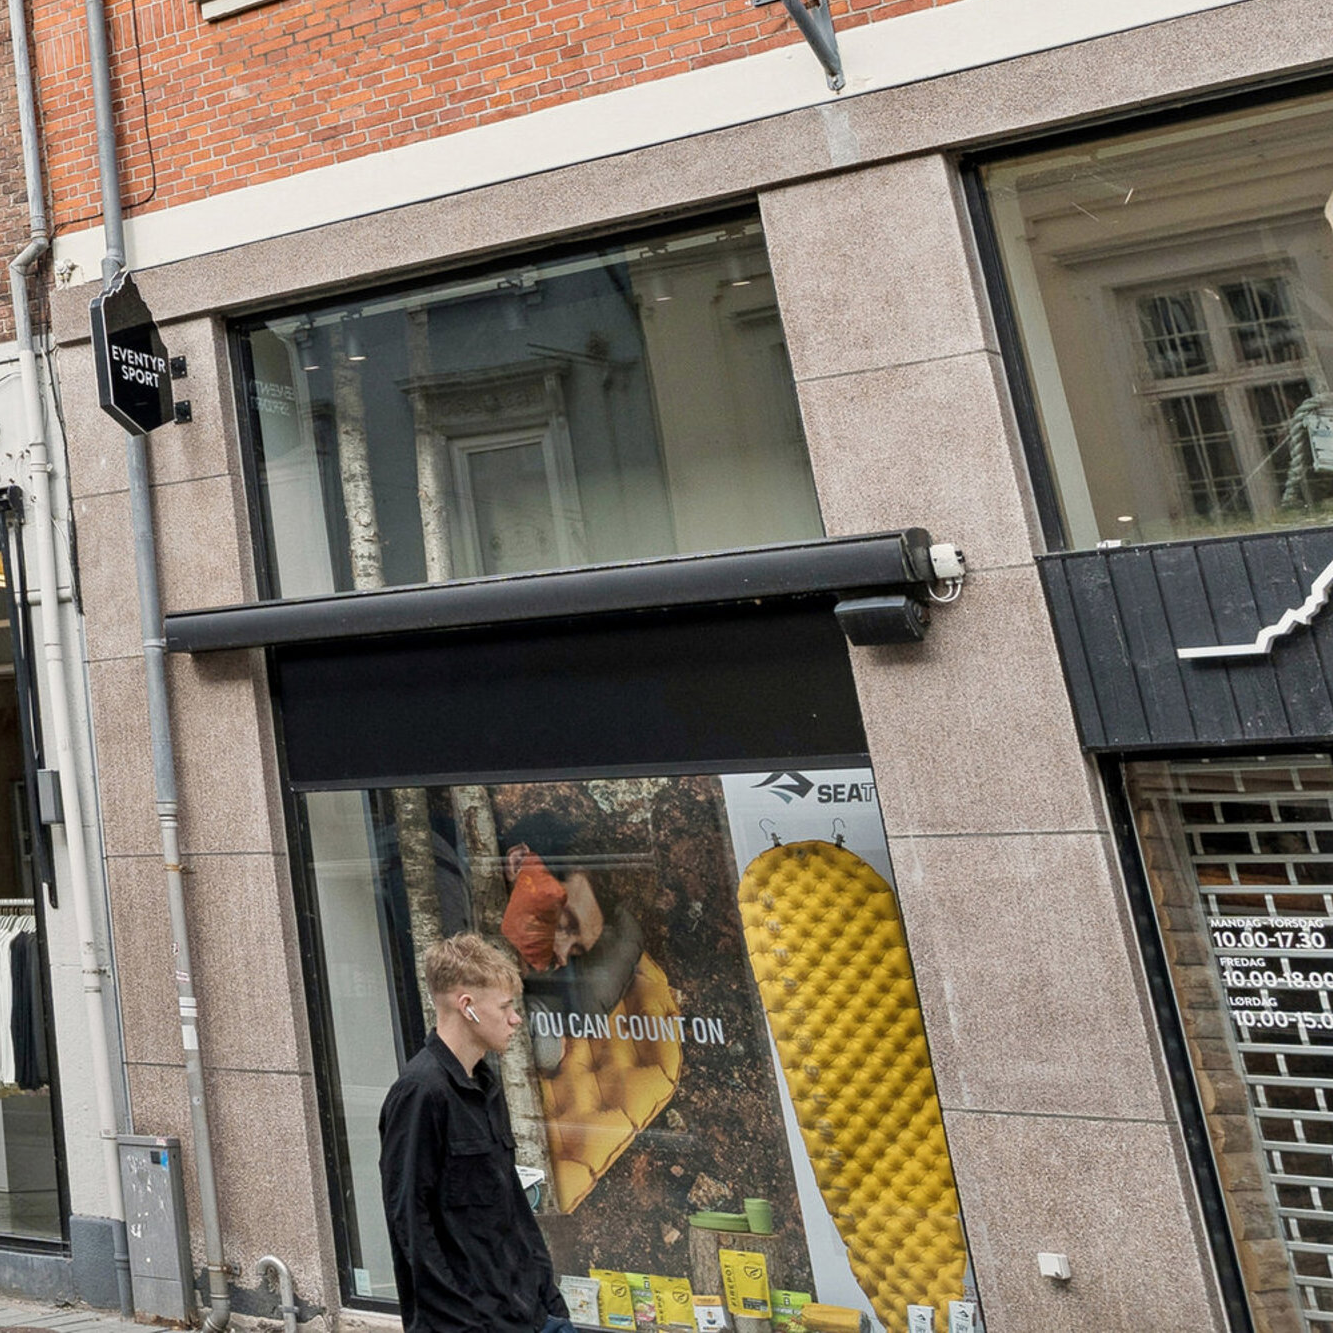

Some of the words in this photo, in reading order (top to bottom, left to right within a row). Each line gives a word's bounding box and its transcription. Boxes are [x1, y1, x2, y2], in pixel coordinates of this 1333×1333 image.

[111, 344, 167, 374] EVENTYR
[121, 365, 160, 389] SPORT
[1213, 930, 1326, 949] 10.00-17.30
[1219, 957, 1266, 967] FREDAG
[1222, 970, 1333, 988] 10.00-18.00
[1229, 997, 1278, 1007] LØRDAG
[568, 1012, 612, 1040] CAN
[615, 1014, 685, 1043] COUNT
[691, 1017, 726, 1045] ON
